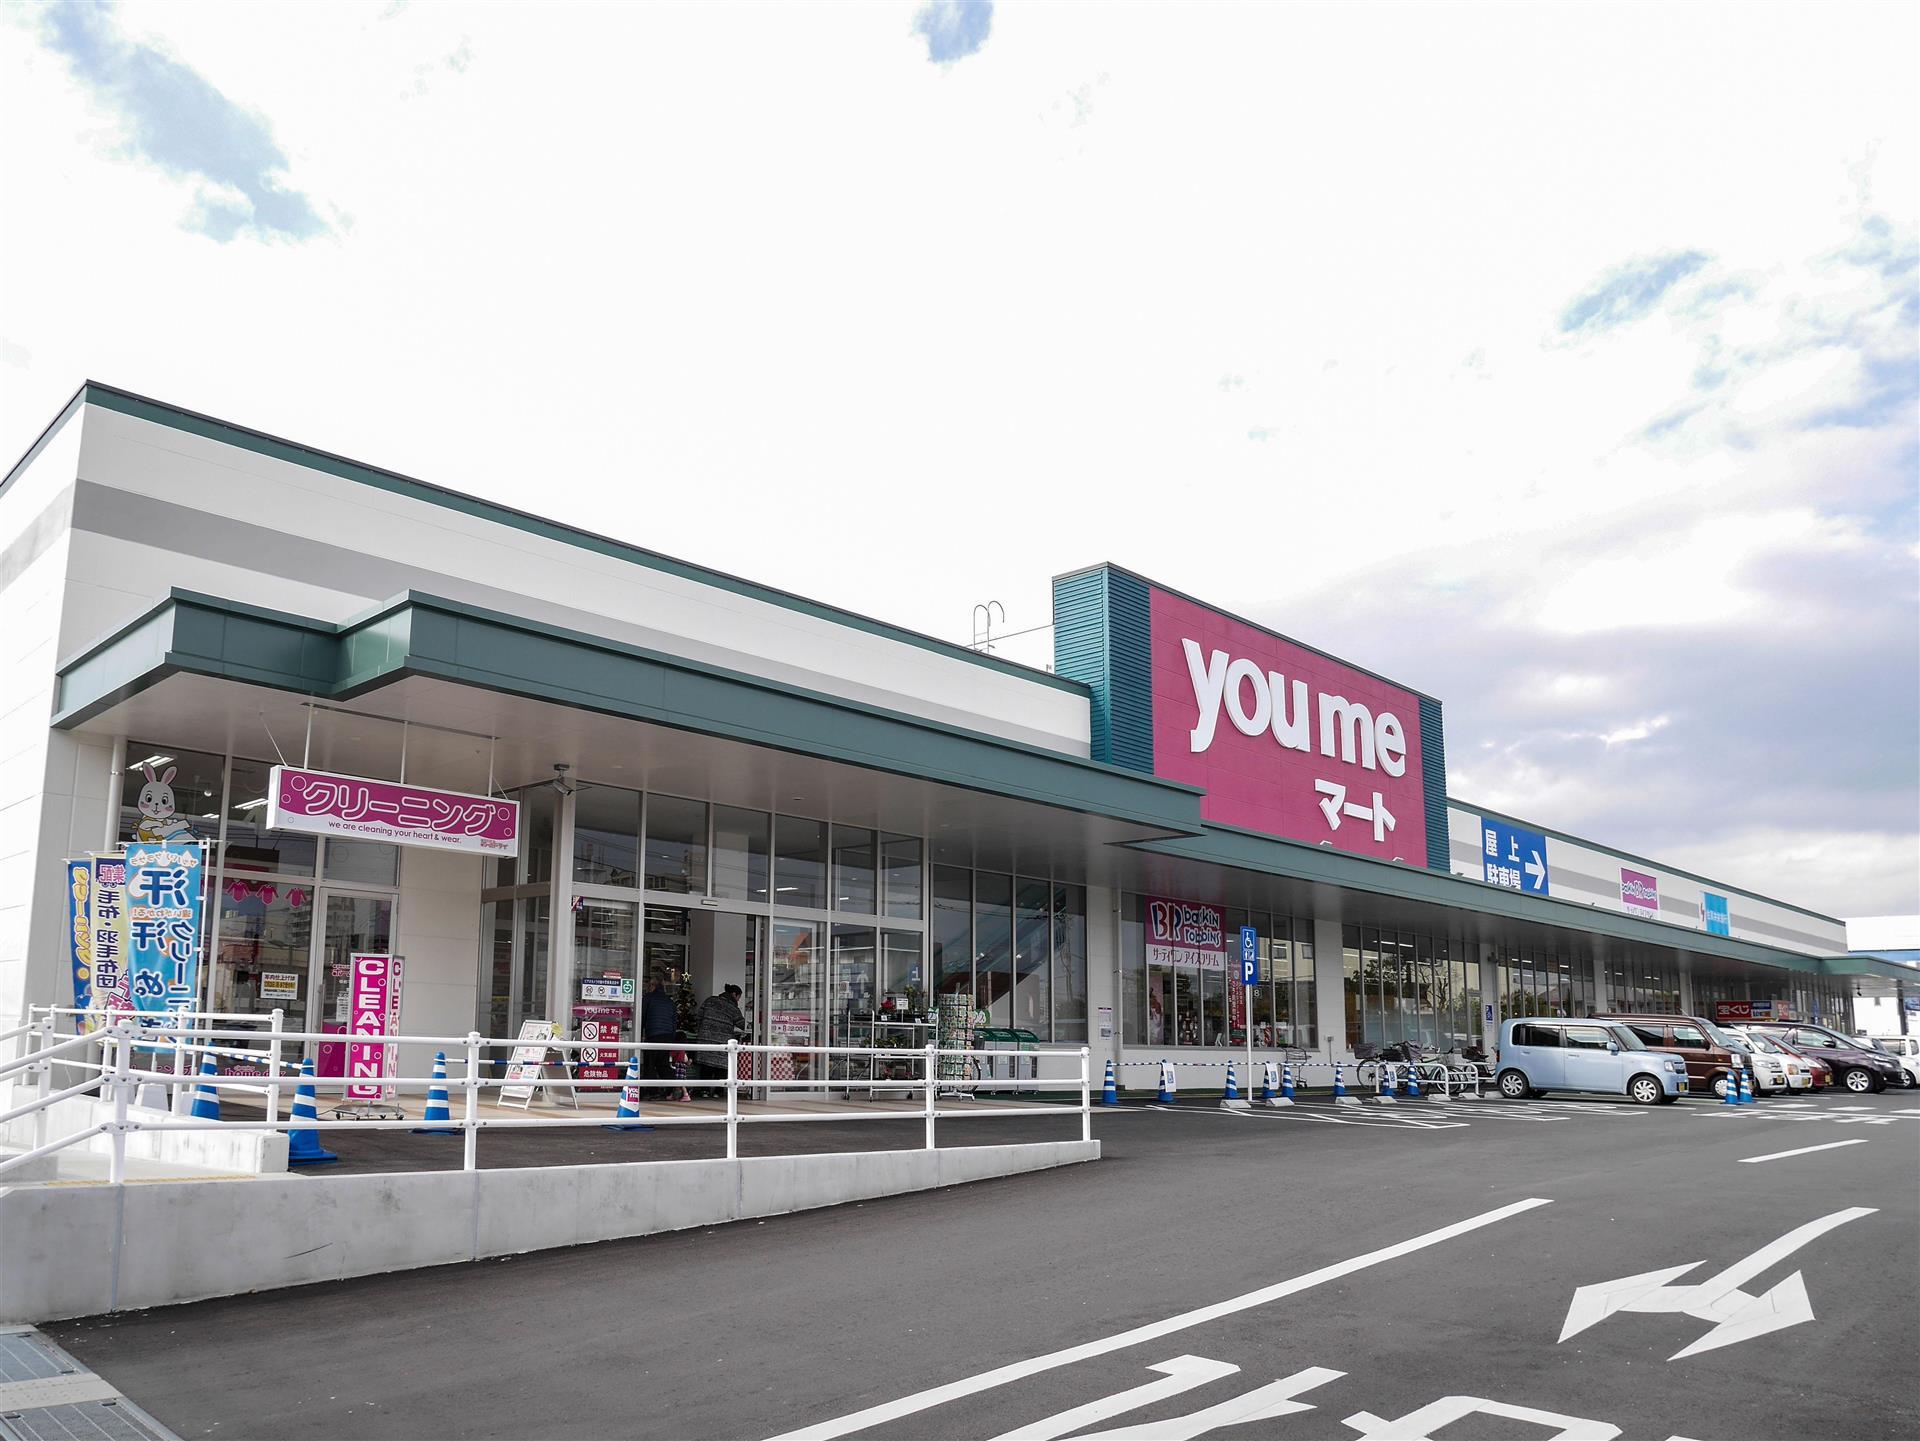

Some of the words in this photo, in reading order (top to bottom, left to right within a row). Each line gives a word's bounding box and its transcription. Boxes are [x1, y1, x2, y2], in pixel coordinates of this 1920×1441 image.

[303, 781, 496, 836] クリーニング
[1314, 779, 1396, 842] マート
[343, 823, 356, 831] are
[358, 824, 392, 836] cleaning
[395, 829, 411, 838] your
[413, 831, 433, 840] heart
[1485, 828, 1520, 862] 屋上
[1486, 862, 1521, 889] 駐車場
[1150, 901, 1183, 941] BR
[1183, 905, 1219, 929] baskin
[1184, 927, 1221, 948] robbins
[1244, 962, 1254, 981] P
